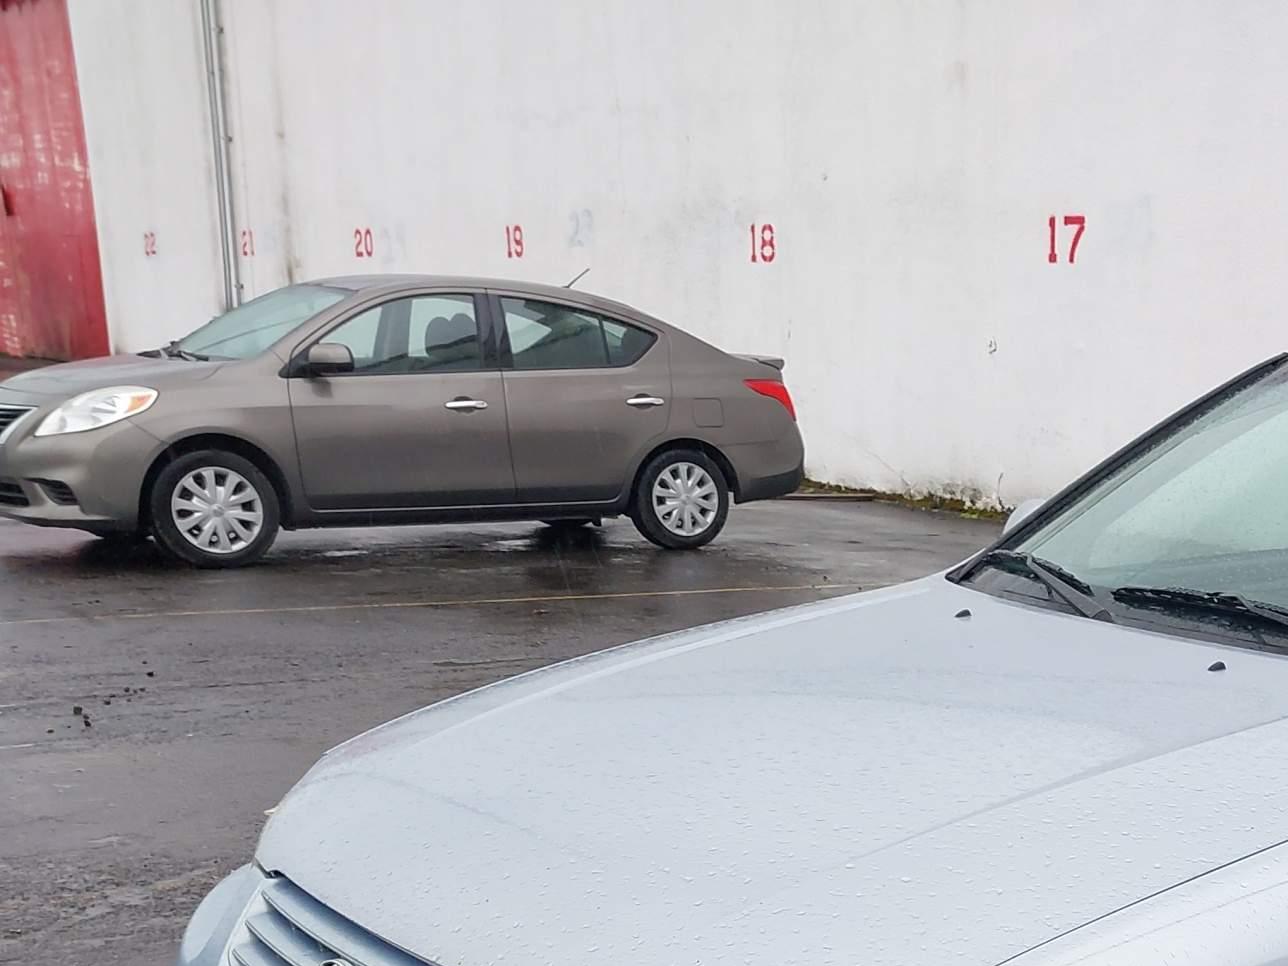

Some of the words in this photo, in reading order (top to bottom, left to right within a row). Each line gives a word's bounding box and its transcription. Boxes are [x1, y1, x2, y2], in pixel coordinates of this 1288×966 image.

[241, 229, 255, 256] 21
[353, 228, 373, 258] 20
[504, 224, 524, 258] 19
[751, 223, 776, 264] 18
[1047, 214, 1086, 264] 17
